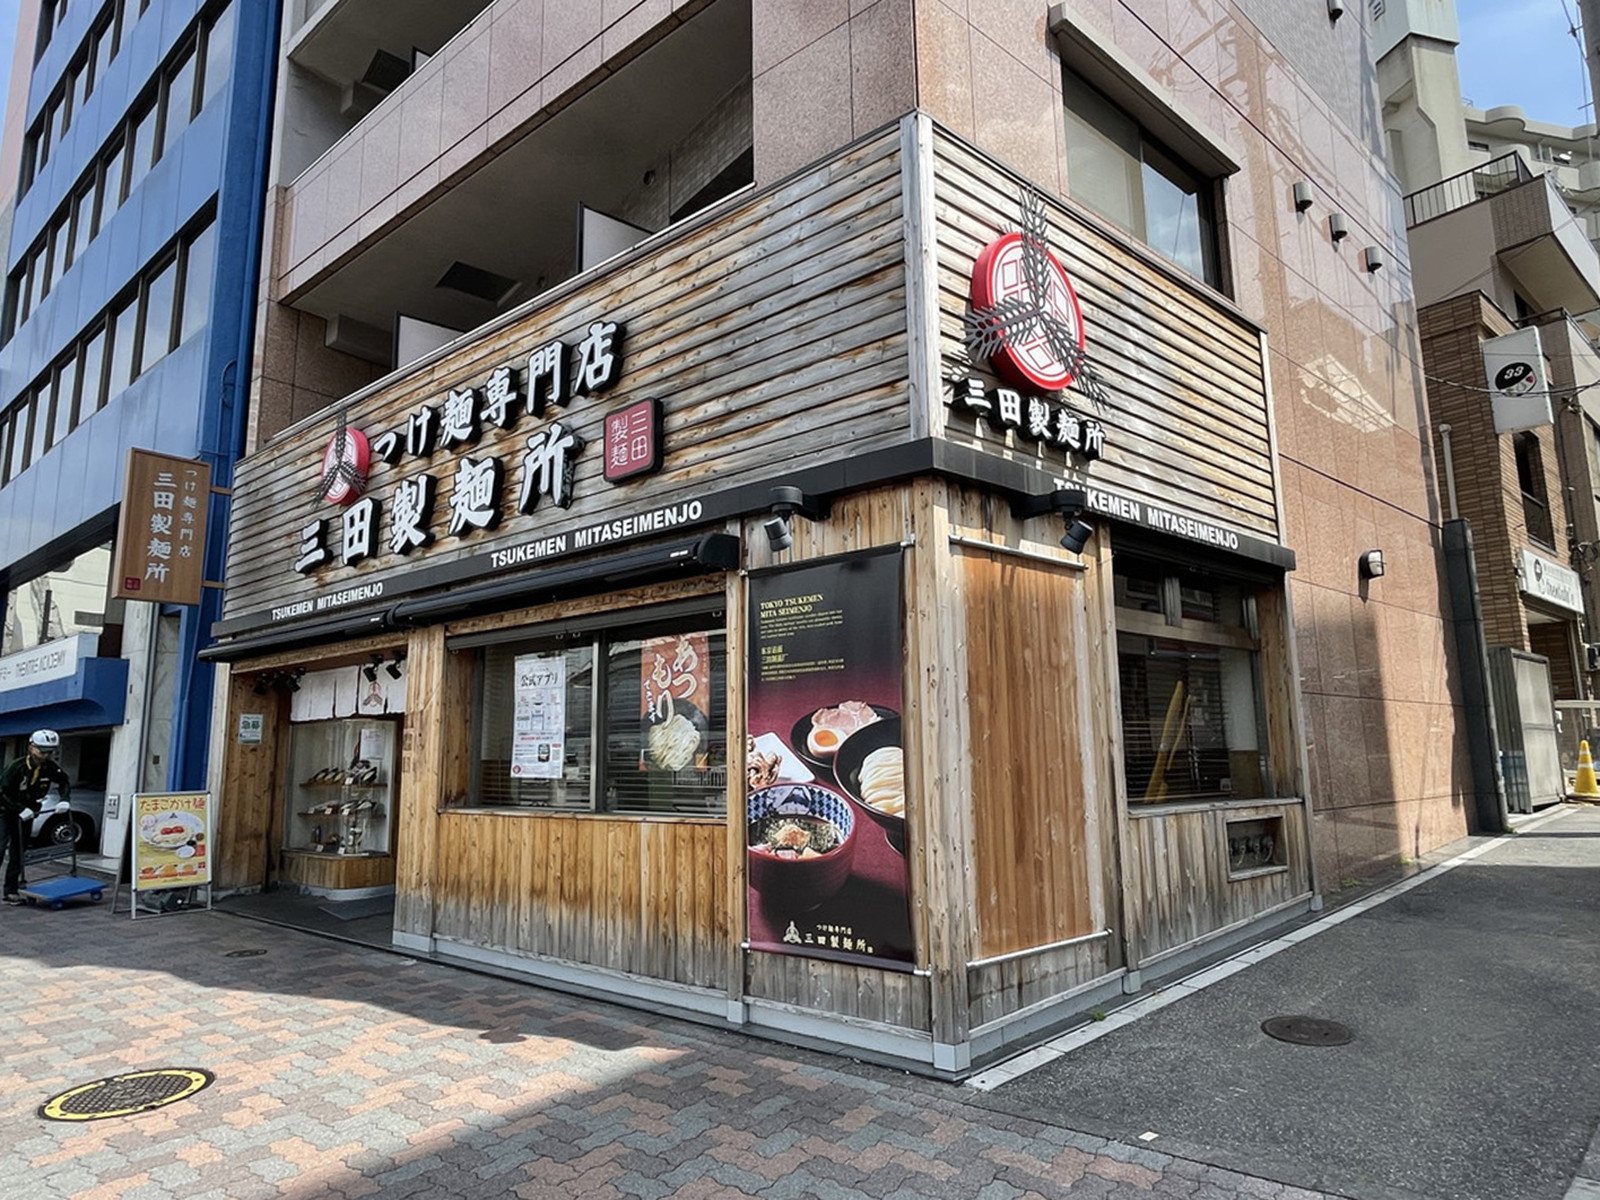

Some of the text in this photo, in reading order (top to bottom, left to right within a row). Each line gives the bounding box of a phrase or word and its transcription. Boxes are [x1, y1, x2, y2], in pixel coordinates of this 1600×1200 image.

[373, 321, 620, 460] つけ麺専門店
[1504, 365, 1524, 380] 33
[964, 377, 1105, 458] 三田製麺所
[179, 469, 198, 558] つけ麺専門店
[294, 421, 578, 572] 三田製麺所
[144, 472, 178, 584] 三田製麺所
[491, 499, 703, 569] TSUKEMEN MITASEIMENJO
[1148, 506, 1239, 550] MITASEIMENJO
[271, 581, 383, 621] TSUKEMEN MITASEIMENJO
[760, 599, 784, 610] TOKYO
[760, 609, 777, 618] MITA
[140, 797, 205, 811] たまごかけ麺
